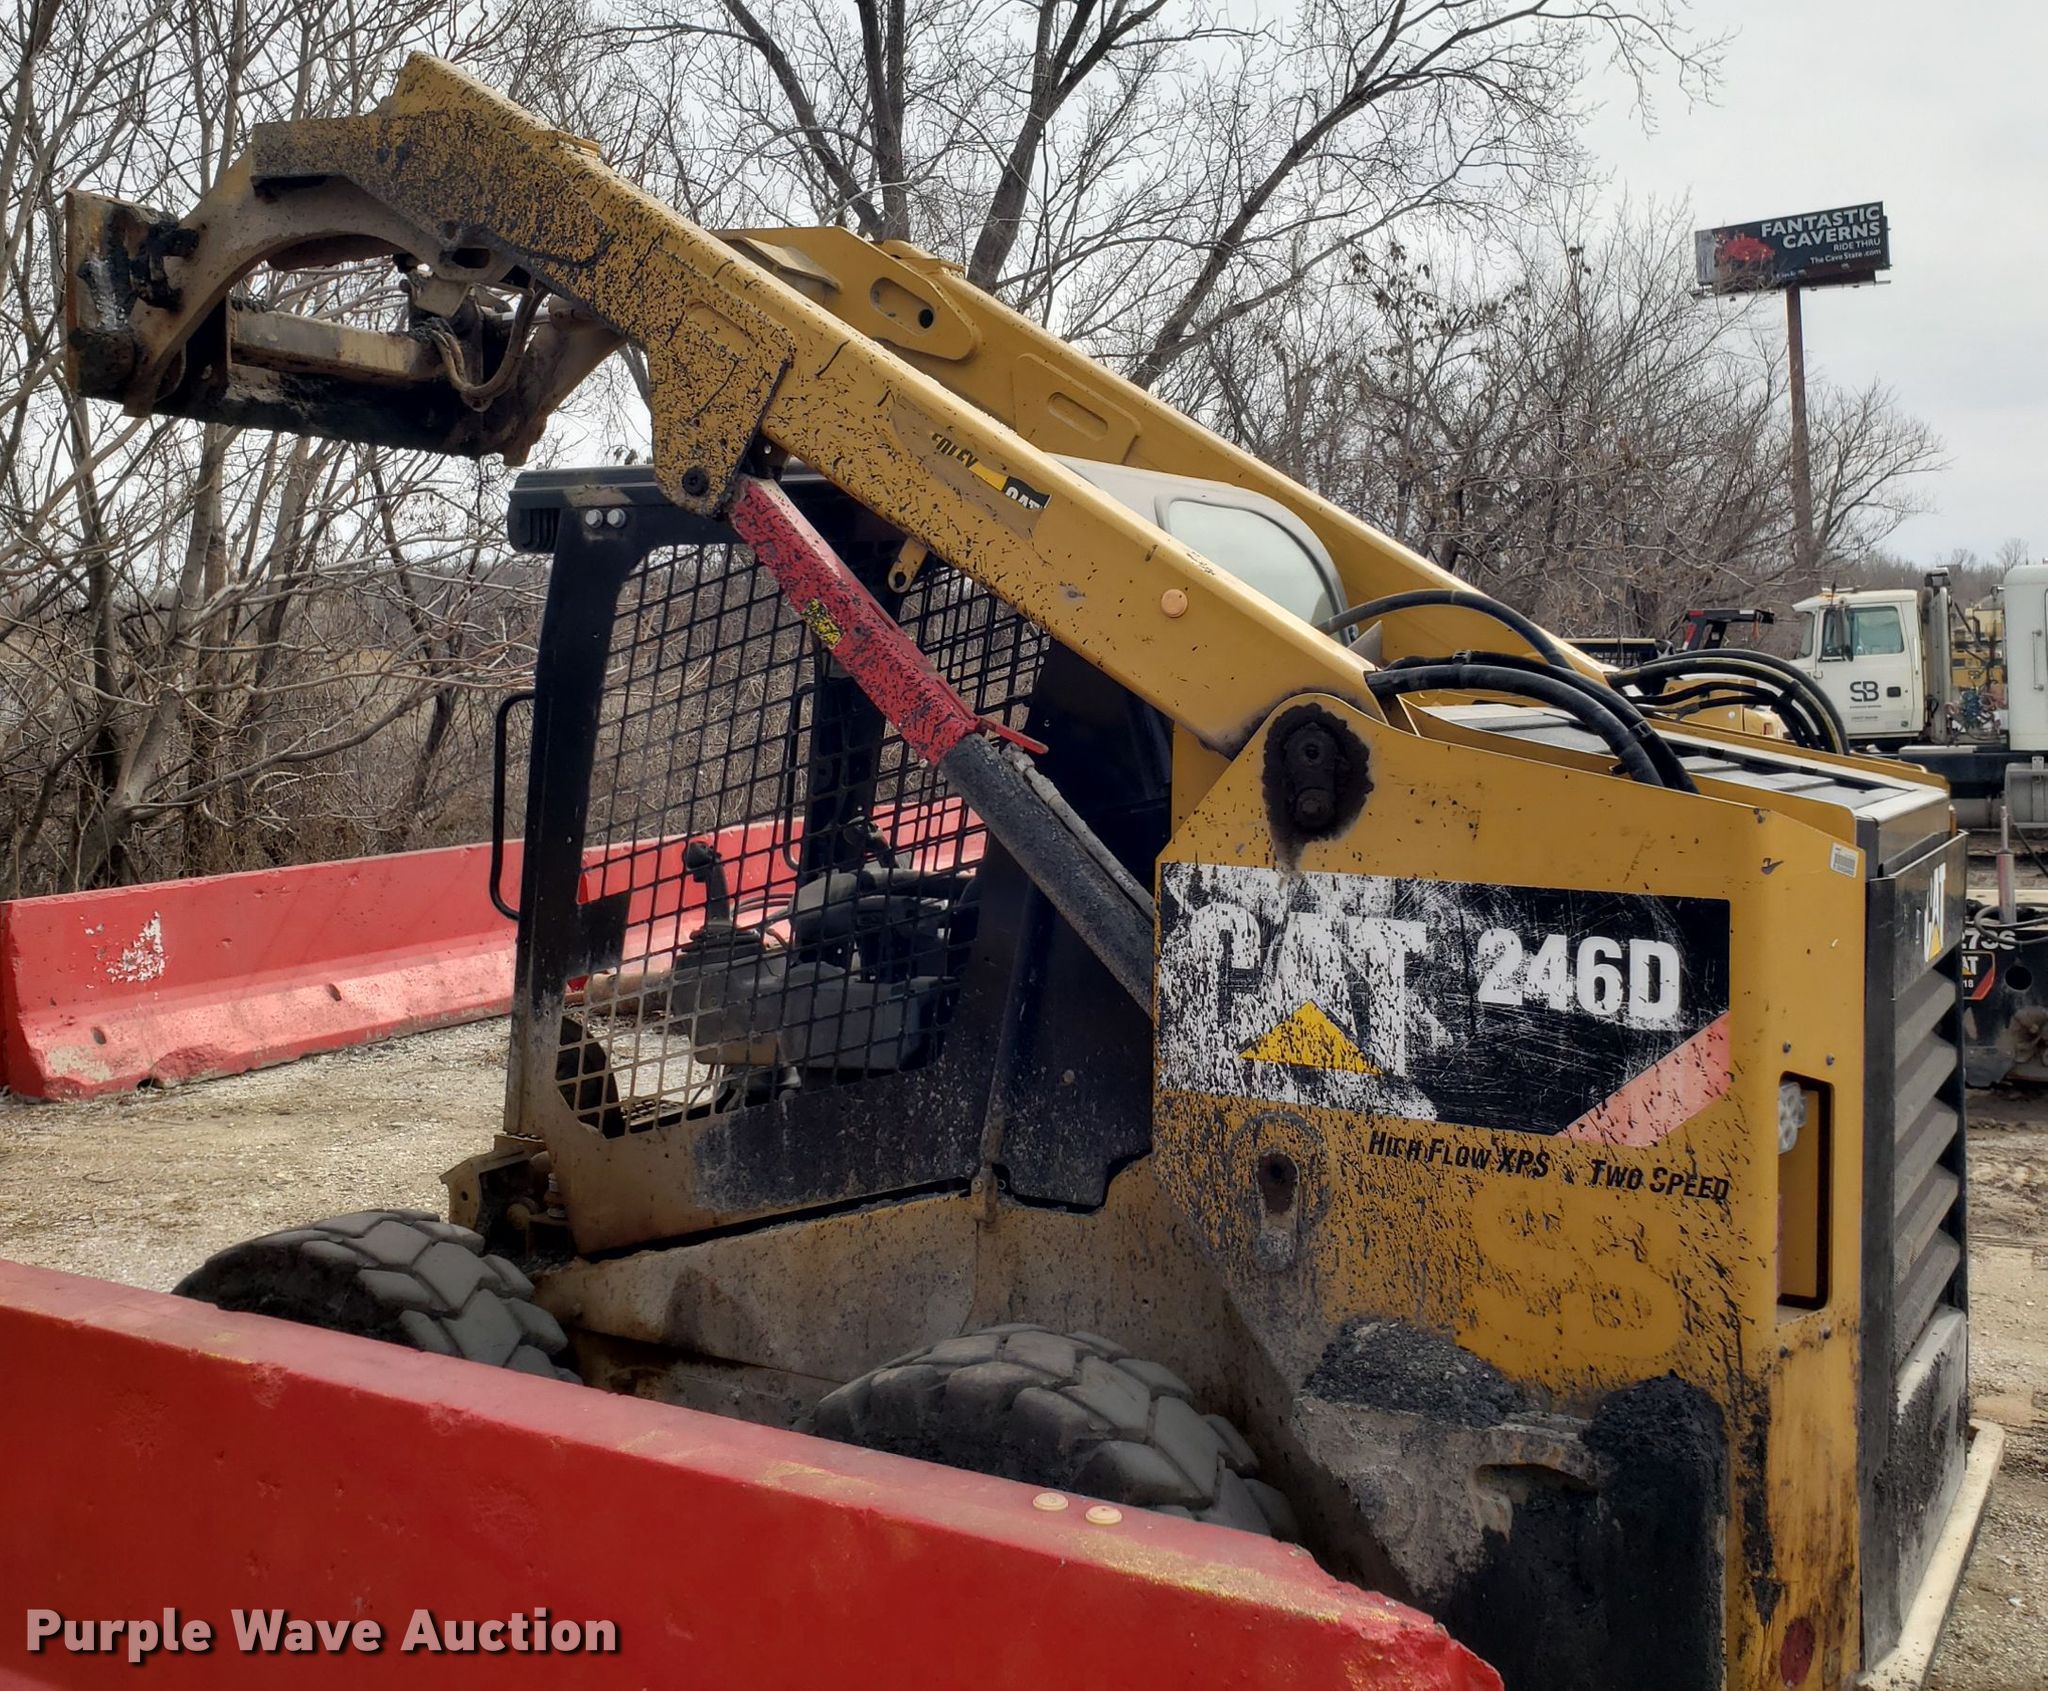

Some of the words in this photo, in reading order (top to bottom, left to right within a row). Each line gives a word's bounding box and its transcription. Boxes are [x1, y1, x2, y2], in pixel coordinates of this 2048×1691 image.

[1761, 205, 1880, 238] FANTASTIC
[1783, 222, 1880, 249] CAVERNS
[1833, 241, 1854, 252] RIDE
[1855, 238, 1881, 249] THRU
[1850, 680, 1879, 703] SB
[1188, 902, 1428, 1077] CAT
[1477, 928, 1681, 1020] 246D
[1369, 1130, 1424, 1162] HIGH
[1426, 1137, 1491, 1170] FLOW
[1497, 1146, 1551, 1178] XPS
[1590, 1158, 1643, 1190] TWO
[1650, 1166, 1730, 1202] SPEED
